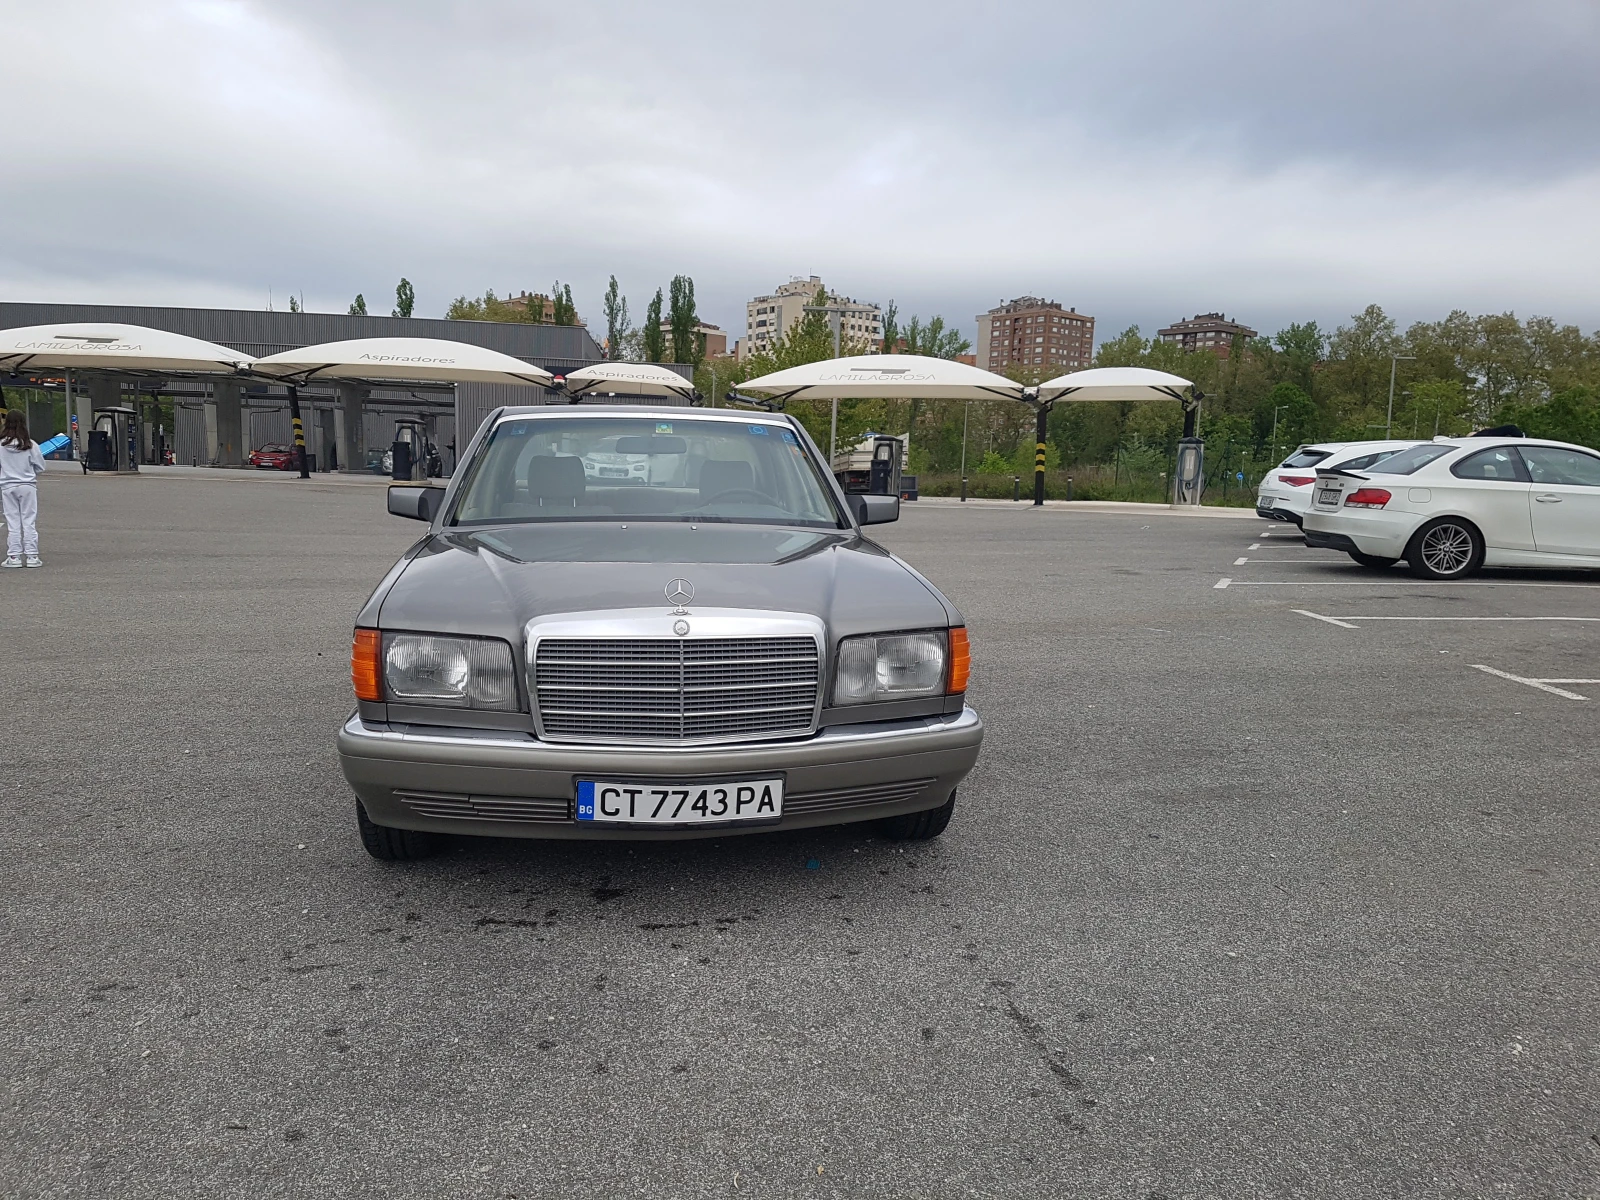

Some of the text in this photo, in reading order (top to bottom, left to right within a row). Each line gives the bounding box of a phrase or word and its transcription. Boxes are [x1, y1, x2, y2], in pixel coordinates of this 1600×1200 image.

[359, 353, 456, 364] Aspiradores
[586, 369, 678, 381] Aspiradores
[578, 805, 593, 815] BG
